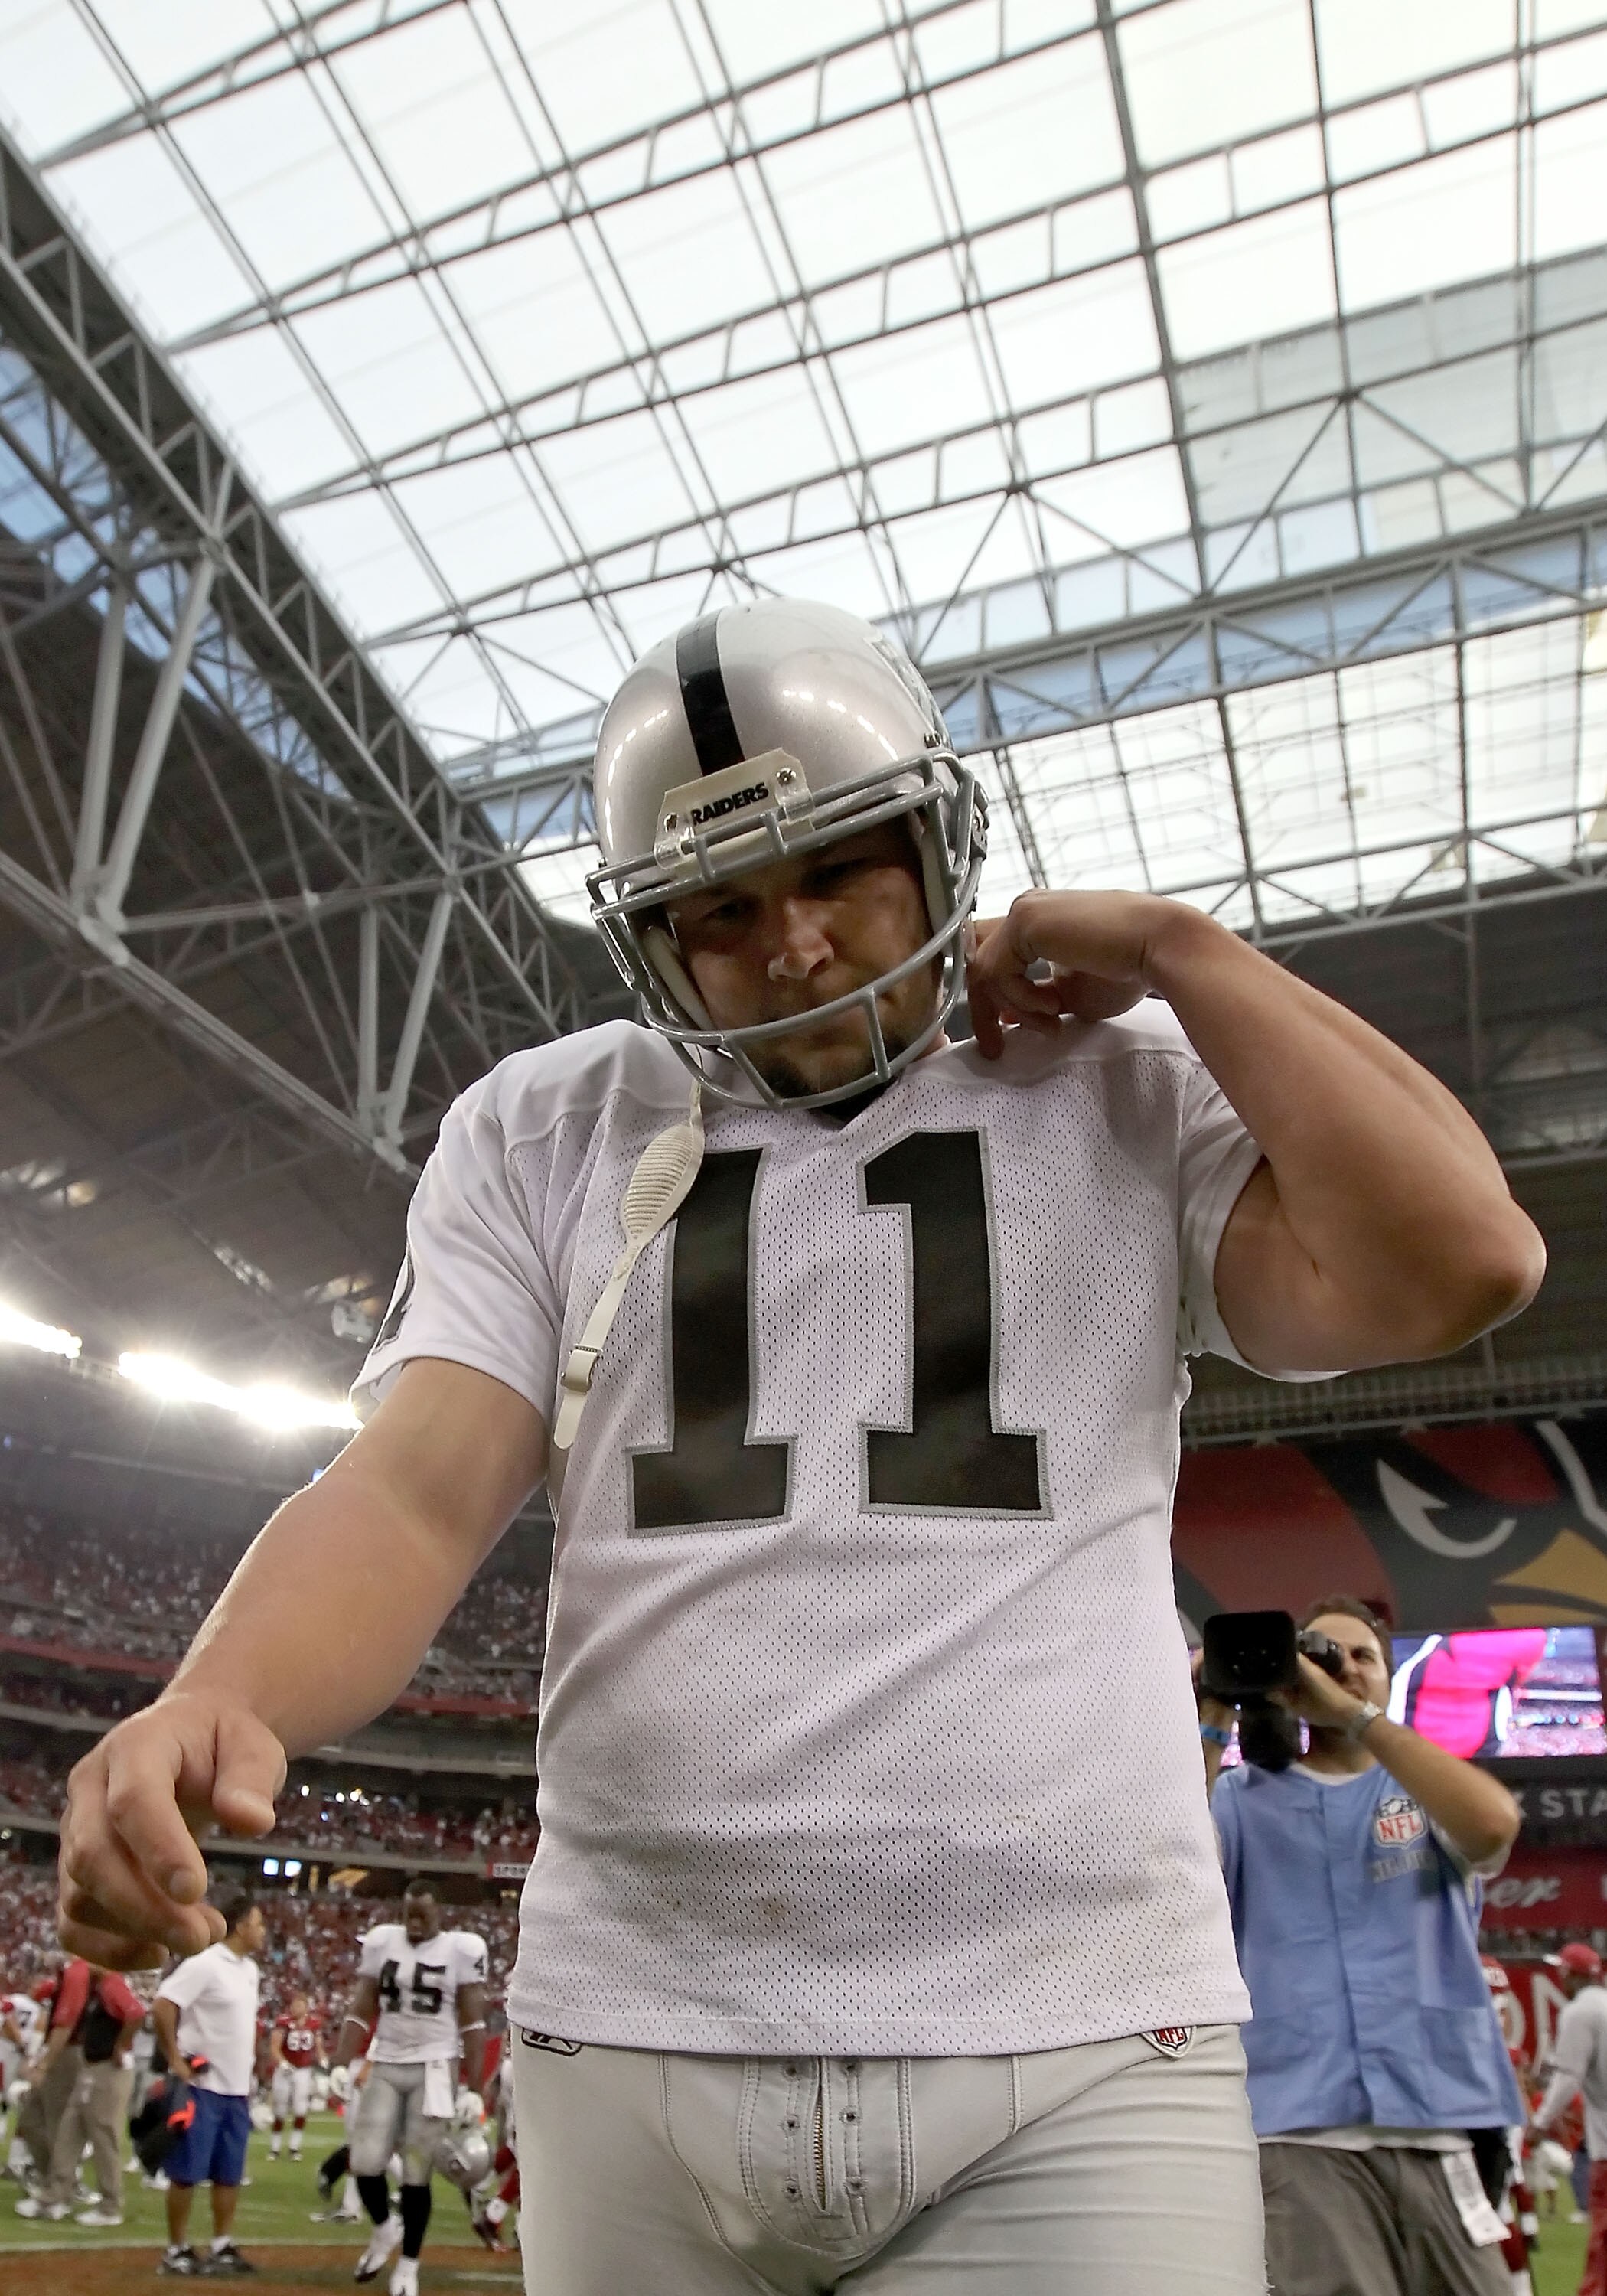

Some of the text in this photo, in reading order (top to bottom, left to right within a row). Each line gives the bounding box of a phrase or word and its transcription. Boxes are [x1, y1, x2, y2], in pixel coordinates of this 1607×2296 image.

[691, 782, 769, 825] RAIDERS
[621, 1127, 1054, 1538] 11
[1379, 1814, 1423, 1840] NFL
[380, 1958, 446, 2014] 45
